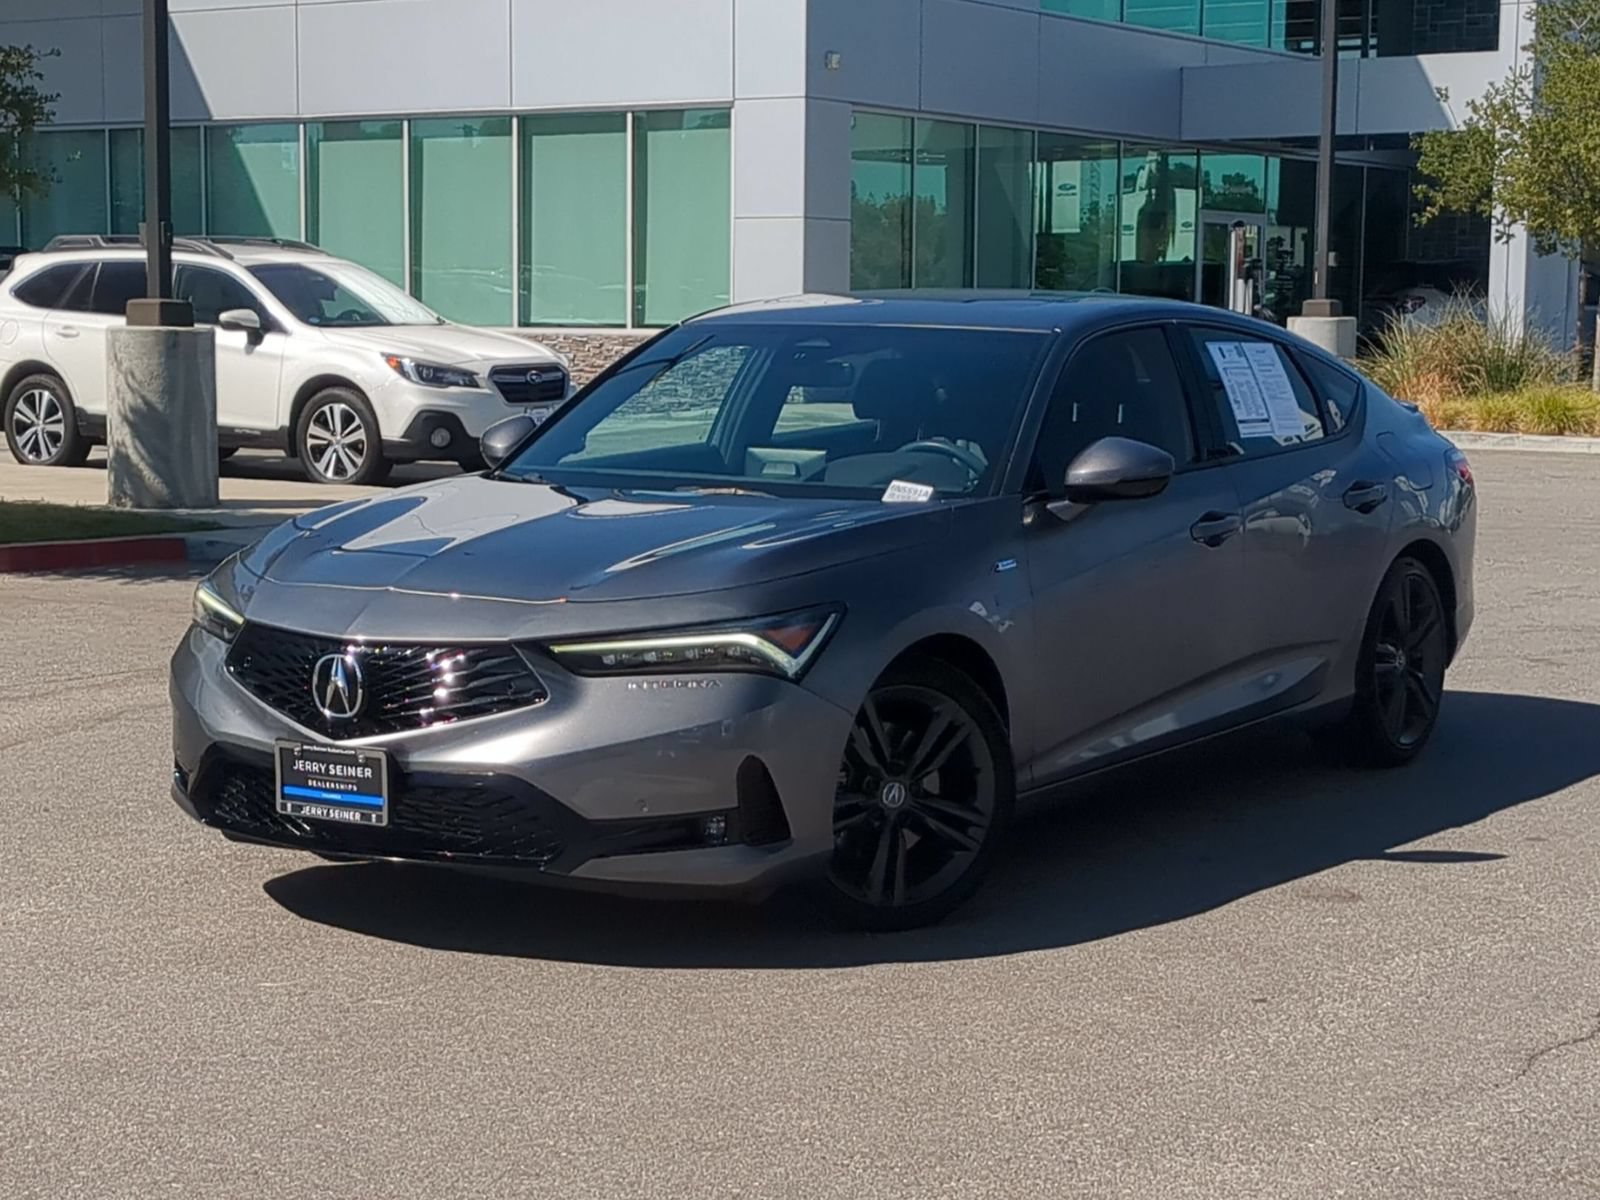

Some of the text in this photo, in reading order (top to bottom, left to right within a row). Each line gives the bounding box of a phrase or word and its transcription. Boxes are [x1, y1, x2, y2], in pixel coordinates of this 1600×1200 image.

[292, 759, 373, 779] JERRY SEINER
[307, 779, 358, 791] DEALERSHIPS
[300, 805, 361, 821] JERRY SEINER
